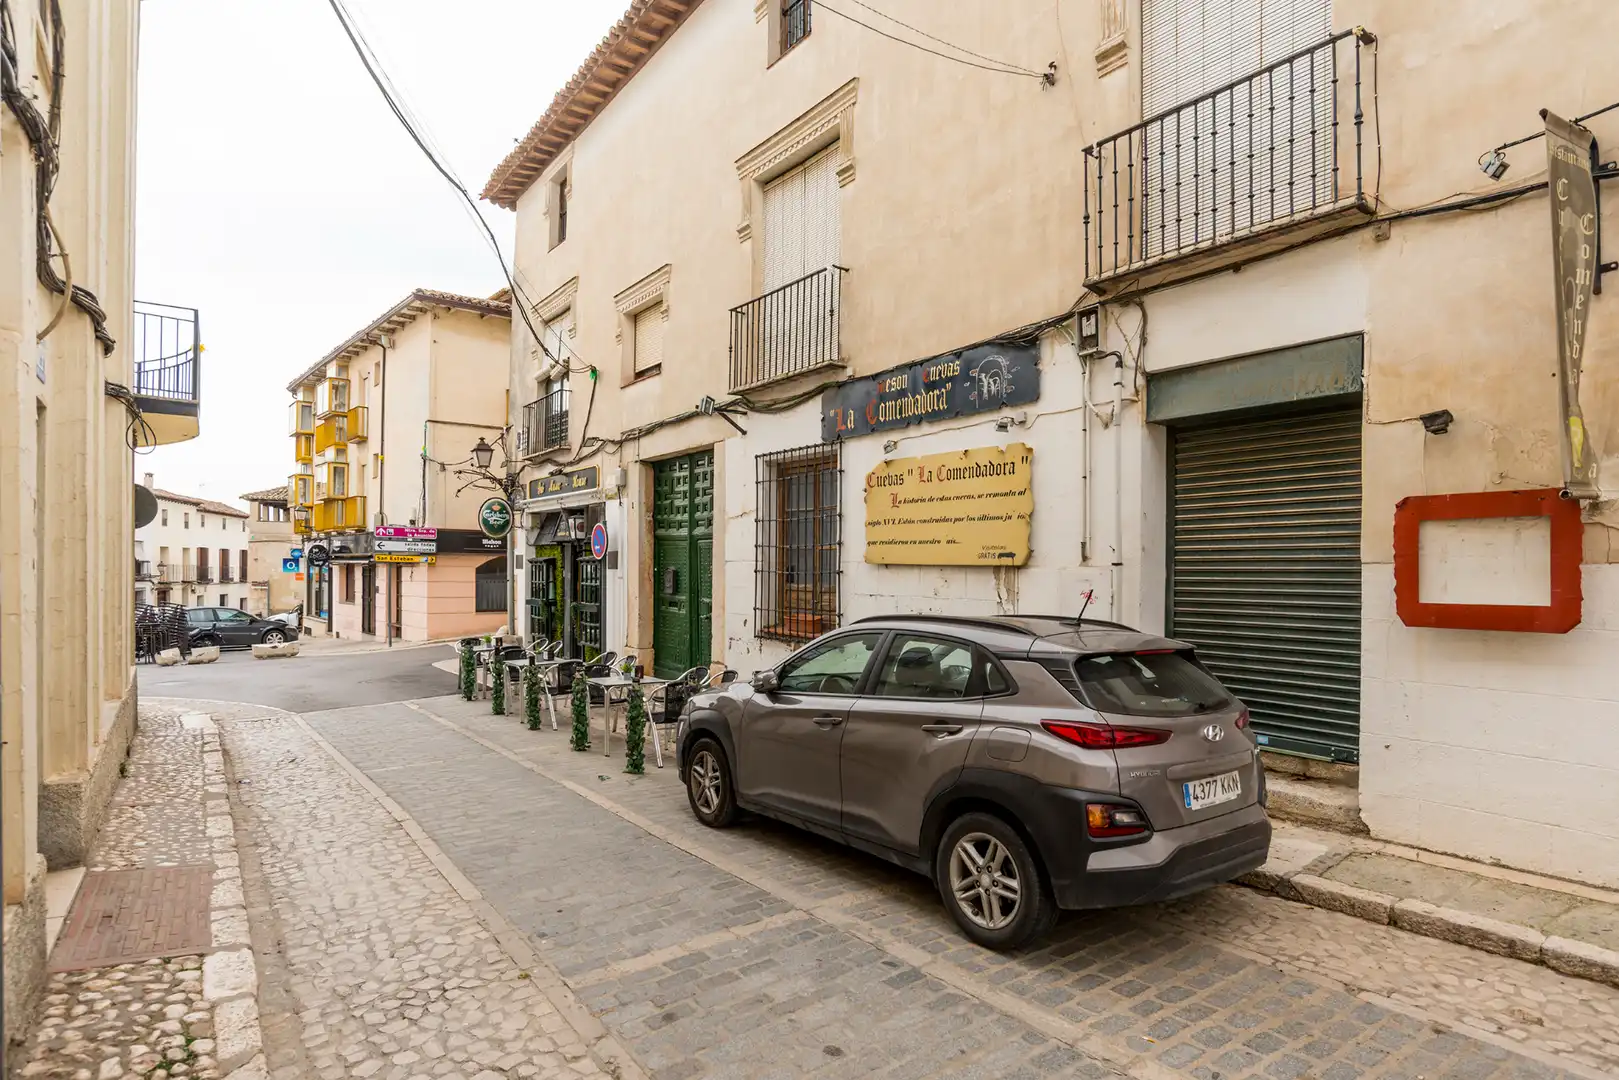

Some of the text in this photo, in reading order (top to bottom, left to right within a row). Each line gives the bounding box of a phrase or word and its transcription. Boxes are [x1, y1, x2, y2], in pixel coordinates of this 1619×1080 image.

[922, 360, 961, 382] Cuevas
[867, 471, 905, 488] Cuevas
[889, 491, 902, 509] La
[902, 496, 927, 505] historia
[927, 495, 934, 503] de
[985, 489, 1017, 499] remonta
[1017, 488, 1027, 496] al
[867, 519, 882, 527] siglo
[953, 516, 965, 524] por
[1192, 779, 1218, 803] 4377
